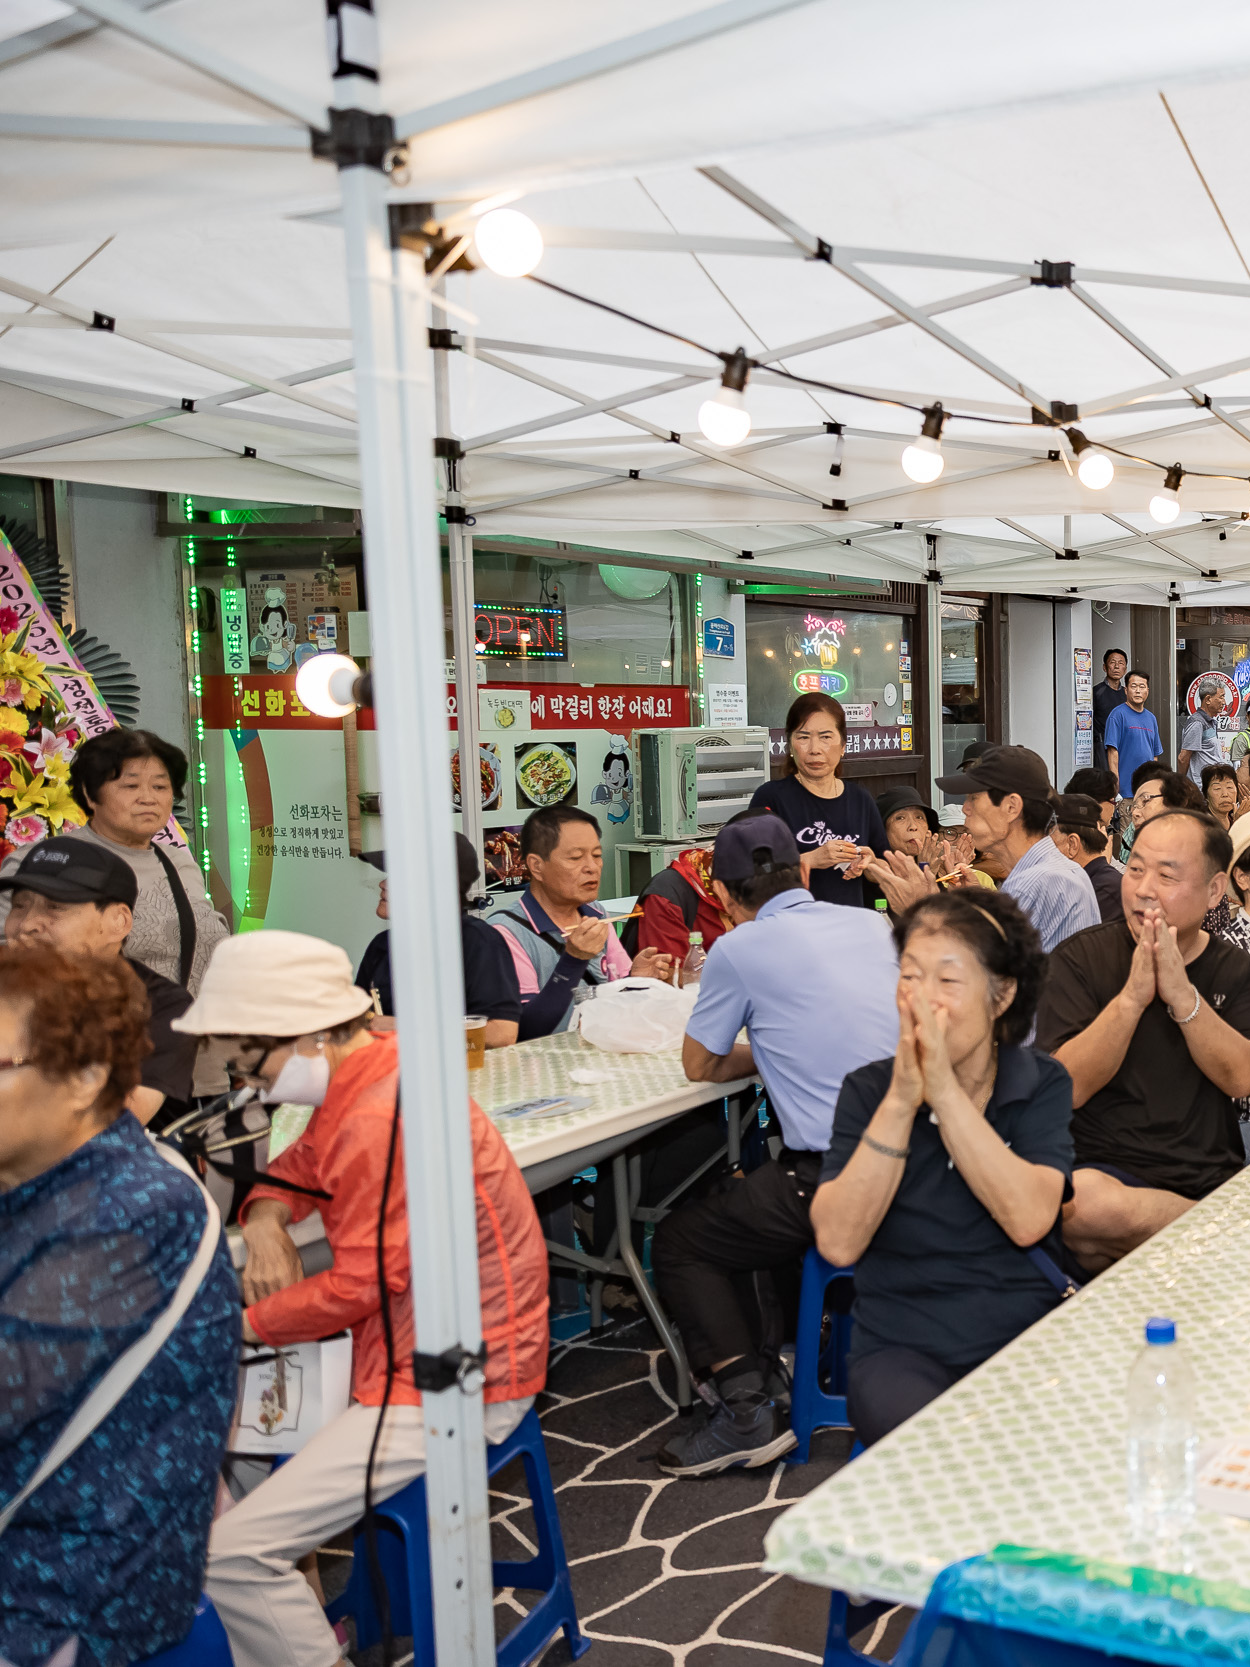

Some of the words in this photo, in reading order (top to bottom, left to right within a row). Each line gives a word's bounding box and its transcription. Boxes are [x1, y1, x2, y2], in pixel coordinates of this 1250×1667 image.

[475, 614, 555, 648] OPEN
[715, 636, 724, 652] 7
[798, 674, 840, 692] 호프치킨
[241, 688, 313, 717] 선화포
[549, 694, 594, 720] 막걸리
[597, 695, 626, 720] 한잔
[628, 695, 672, 720] 어때요!
[289, 803, 343, 822] 선화포차는
[259, 825, 288, 838] 정성으로
[290, 826, 319, 840] 정직하게
[321, 827, 345, 840] 맛있고
[256, 843, 278, 857] 건강한
[280, 844, 311, 858] 음식만을
[312, 846, 345, 859] 만듭니다.
